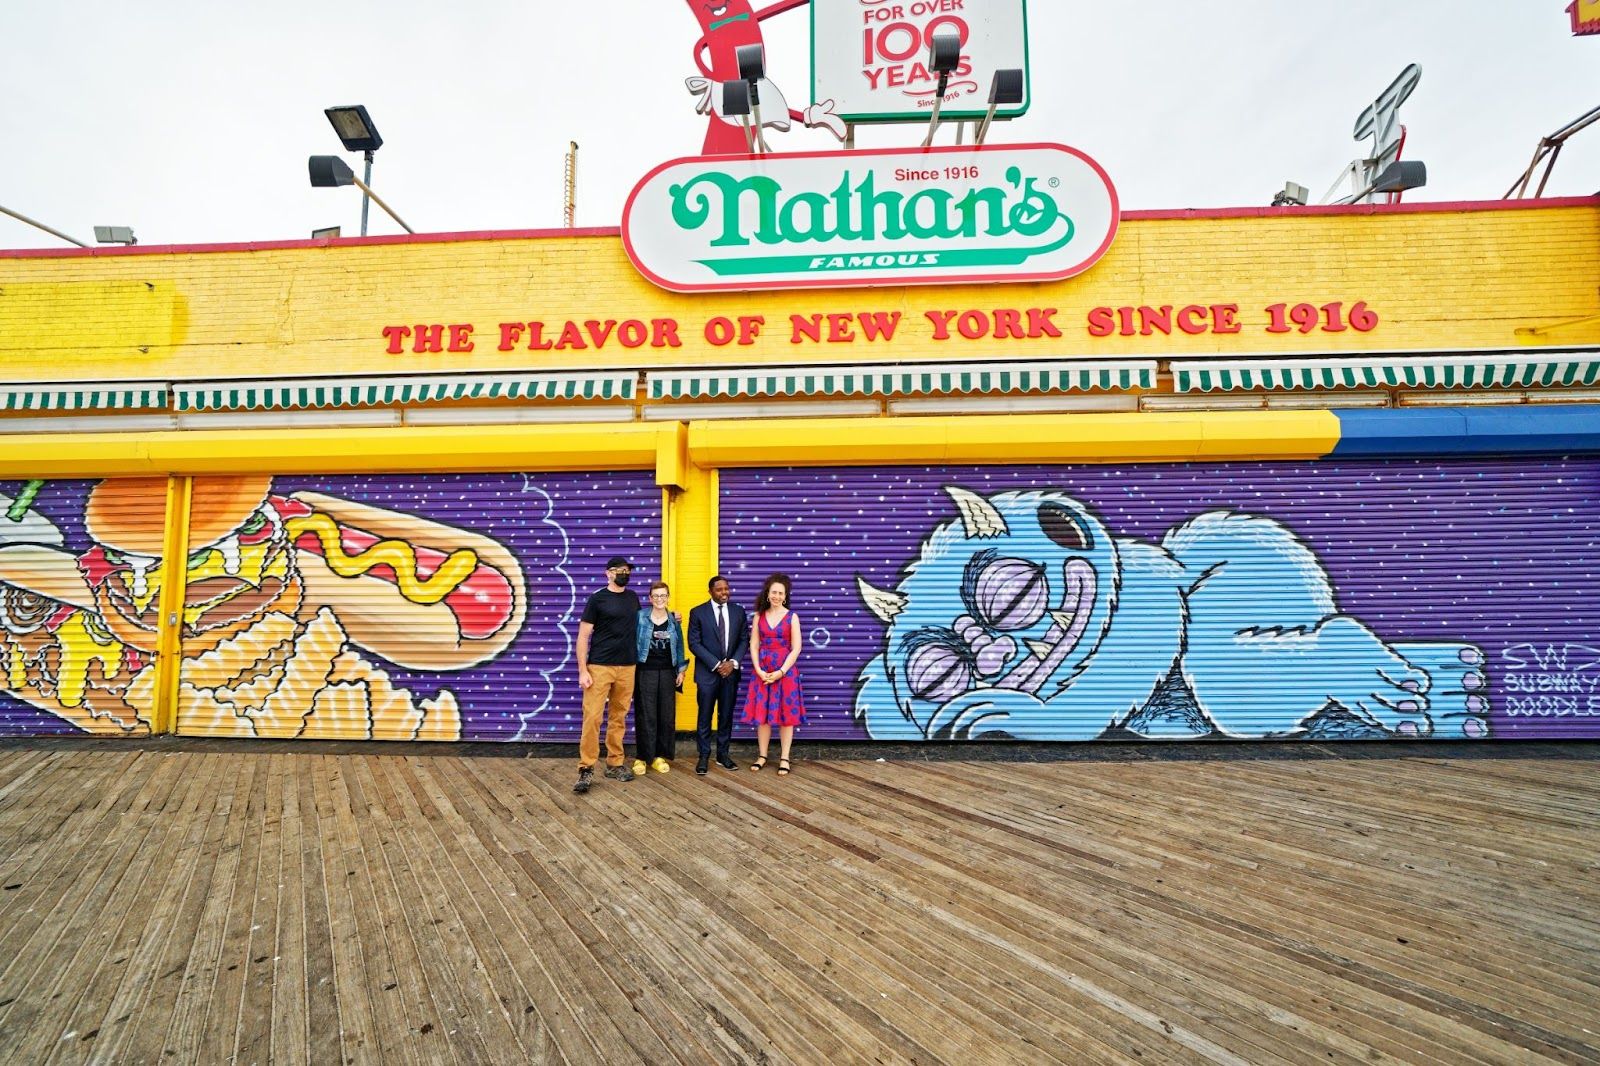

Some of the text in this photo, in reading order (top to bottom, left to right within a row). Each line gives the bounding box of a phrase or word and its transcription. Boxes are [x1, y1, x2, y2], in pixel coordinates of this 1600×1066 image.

[863, 0, 964, 24] FOR OVER
[863, 15, 970, 66] 100
[863, 56, 972, 90] YEAS
[917, 99, 935, 108] Sinc
[894, 166, 979, 181] Since 1916
[668, 166, 1075, 248] Nathan's
[808, 253, 940, 269] FAMOUS
[382, 301, 1379, 354] THE FLAVOR OF NEW YORK SINCE 1916
[1503, 673, 1600, 693] SUBWAY
